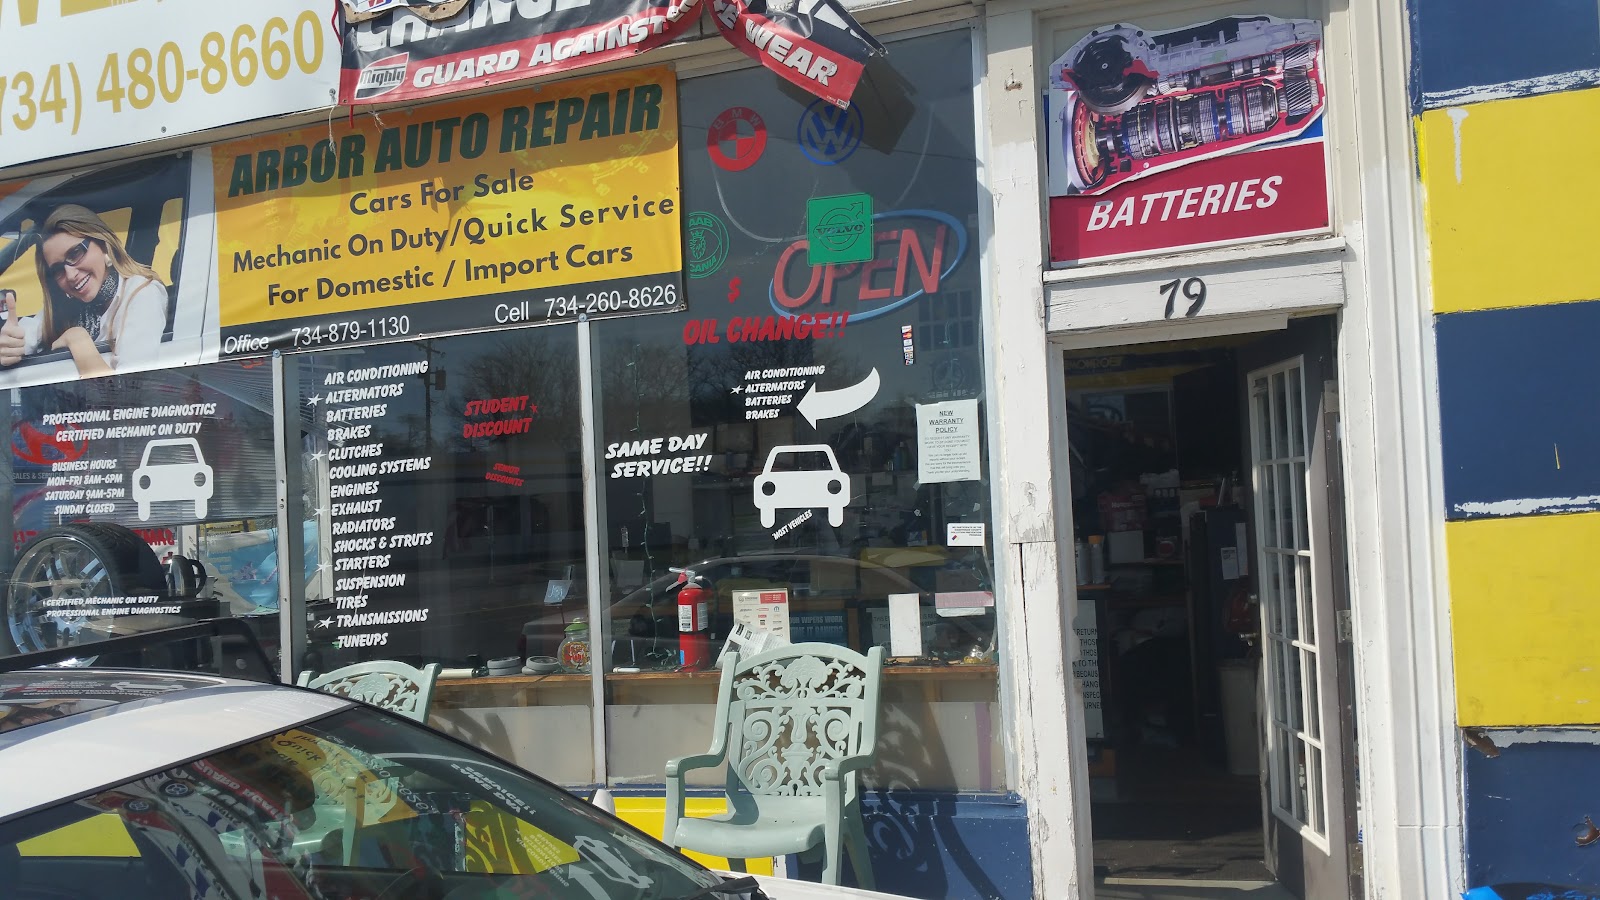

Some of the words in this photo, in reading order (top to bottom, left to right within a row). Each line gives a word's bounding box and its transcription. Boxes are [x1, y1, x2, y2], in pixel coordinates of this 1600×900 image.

[96, 10, 324, 113] 480-8660
[413, 49, 520, 89] GUARD
[528, 15, 667, 67] AGAINST
[745, 18, 838, 86] WEAR
[360, 68, 405, 87] Mighty
[228, 134, 366, 197] ARBOR
[374, 112, 490, 173] AUTO
[498, 83, 664, 153] REPAIR
[350, 191, 412, 216] Cars
[420, 181, 465, 206] For
[473, 167, 535, 196] Sale
[1086, 175, 1283, 232] BATTERIES
[689, 217, 714, 228] AAB
[815, 222, 865, 236] VOLVO
[233, 239, 342, 274] Mechanic
[347, 234, 384, 257] On
[559, 196, 675, 231] Service
[267, 283, 309, 307] For
[316, 266, 435, 300] Domestic
[442, 259, 457, 288] /
[464, 250, 559, 287] Import
[564, 242, 634, 267] Cars
[773, 224, 946, 308] OPEN
[1159, 276, 1207, 320] 79
[223, 334, 270, 355] Office
[291, 314, 411, 349] 734-879-1130
[494, 300, 530, 324] Cell
[544, 283, 677, 319] 734-260-8626
[683, 318, 720, 345] OIL
[726, 311, 850, 343] CHANGE!!
[324, 371, 344, 386] AIR
[347, 360, 429, 383] CONDITIONING
[745, 370, 761, 381] AIR
[762, 365, 825, 379] CONDITIONING
[325, 382, 405, 405] ALTERNATORS
[745, 380, 806, 394] ALTERNATORS
[464, 395, 529, 417] STUDENT
[745, 394, 792, 407] BATTERIES
[42, 408, 111, 427] PROFESSIONAL
[113, 405, 149, 420] ENGINE
[151, 402, 217, 418] DIAGNOSTICS
[326, 404, 387, 423] BATTERIES
[745, 408, 780, 420] BRAKES
[56, 426, 104, 443] CERTIFIED
[106, 424, 157, 439] MECHANIC
[158, 424, 173, 436] ON
[175, 422, 202, 435] DUTY
[327, 425, 371, 442] BRAKES
[463, 417, 533, 439] DISCOUNT
[328, 443, 383, 462] CLUTCHES
[605, 437, 664, 460] SAME
[667, 433, 709, 451] DAY
[52, 460, 89, 472] BUSINESS
[90, 458, 118, 470] HOURS
[329, 462, 377, 480] COOLING
[379, 456, 432, 475] SYSTEMS
[611, 454, 713, 479] SERVICE!!
[46, 475, 82, 487] MON-FRI
[83, 473, 123, 485] 8AM-6PM
[330, 481, 380, 498] ENGINES
[44, 490, 85, 501] SATURDAY
[85, 488, 125, 500] 9AM-5PM
[54, 504, 85, 515] SUNDAY
[85, 503, 115, 514] CLOSED
[331, 499, 382, 517] EXHAUST
[332, 516, 396, 535] RADIATORS
[787, 509, 813, 530] VEHICLES
[333, 536, 376, 554] SHOCKS
[378, 536, 387, 549] &
[389, 531, 433, 548] STRUTS
[334, 554, 391, 571] STARTERS
[335, 573, 406, 592] SUSPENSION
[46, 596, 84, 607] CERTIFIED
[85, 596, 124, 605] MECHANIC
[125, 596, 137, 604] ON
[138, 595, 159, 604] DUTY
[336, 595, 368, 610] TIRES
[46, 608, 100, 618] PROFESSIONAL
[101, 607, 130, 616] ENGINE
[131, 605, 182, 615] DIAGNOSTICS
[337, 608, 429, 628] TRANSMISSIONS
[338, 632, 389, 649] TUNEUPS
